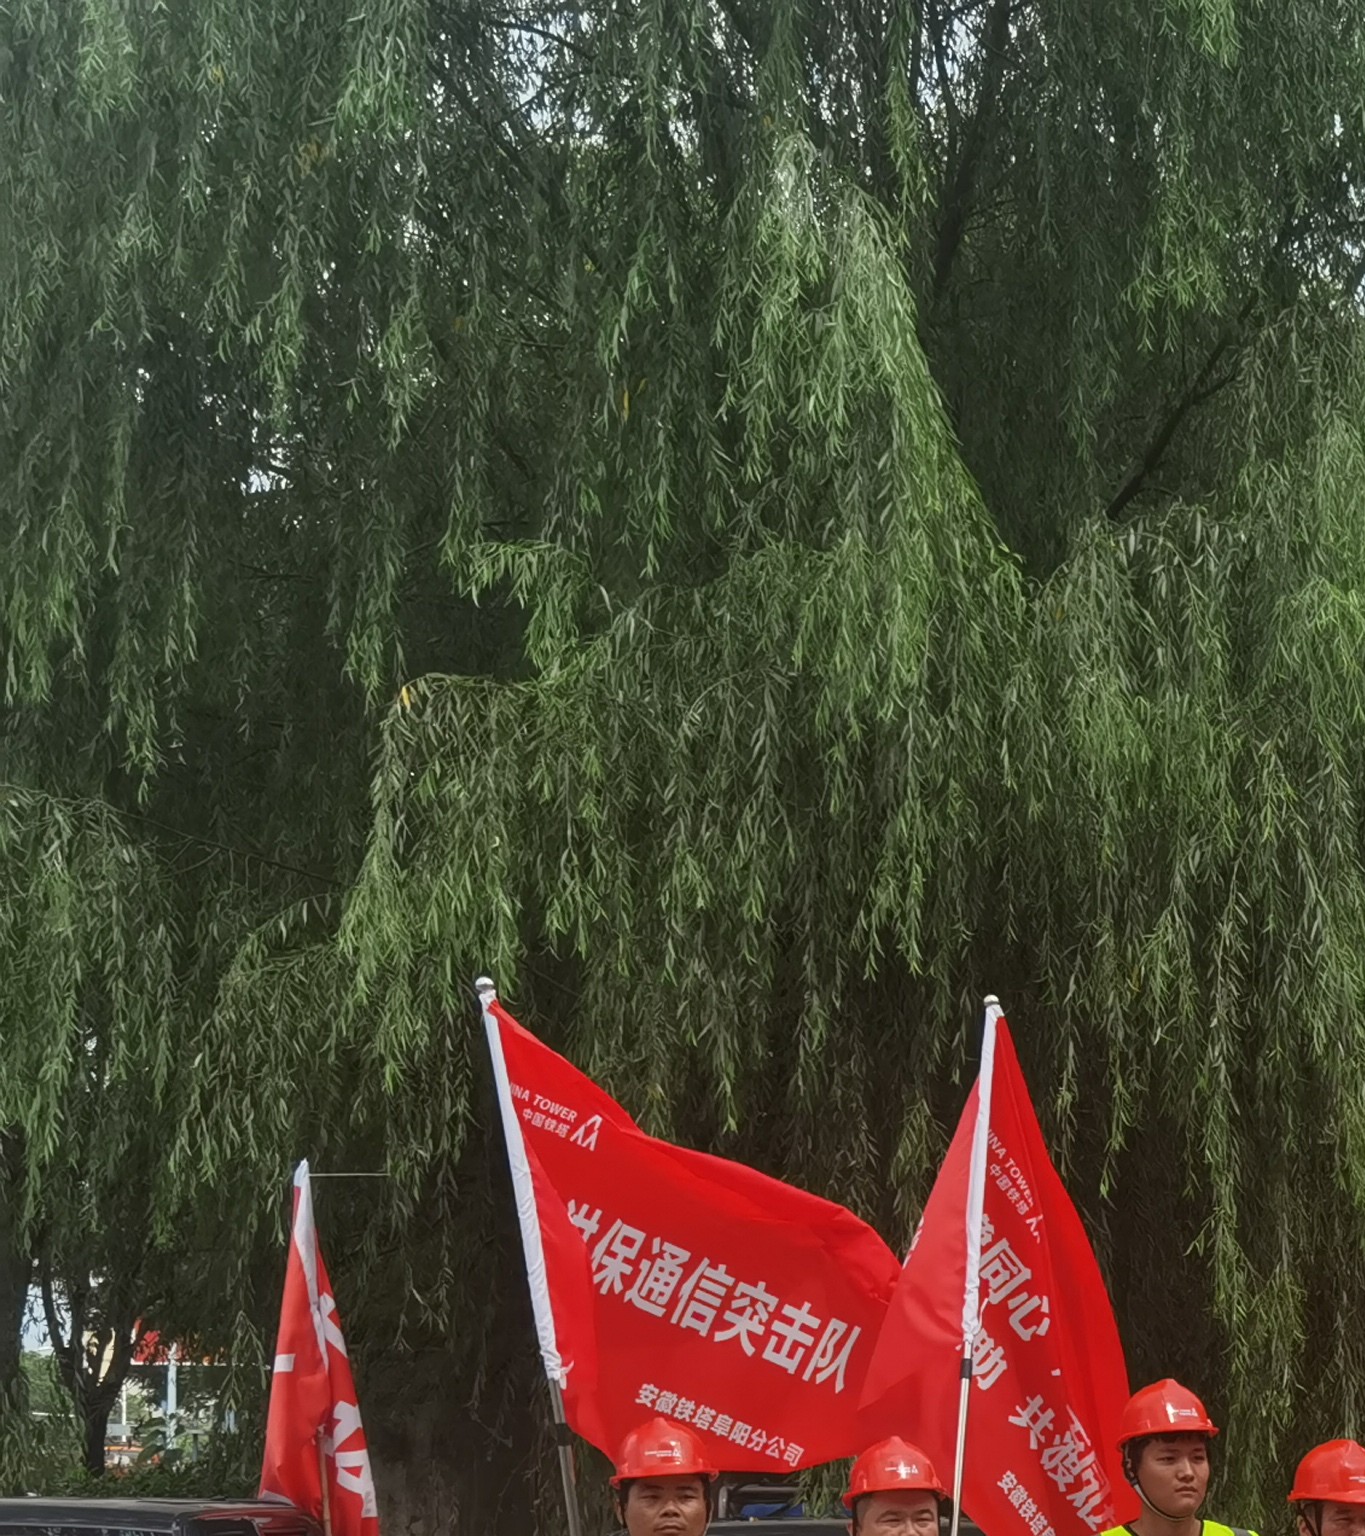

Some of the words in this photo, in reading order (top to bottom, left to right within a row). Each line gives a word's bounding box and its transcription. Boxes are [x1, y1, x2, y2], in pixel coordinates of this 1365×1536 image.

[522, 1107, 571, 1139] 中国铁塔
[533, 1094, 578, 1123] TOWER
[989, 1164, 1030, 1217] 中国铁塔
[635, 1383, 805, 1467] 安徽铁塔阜阳分公司
